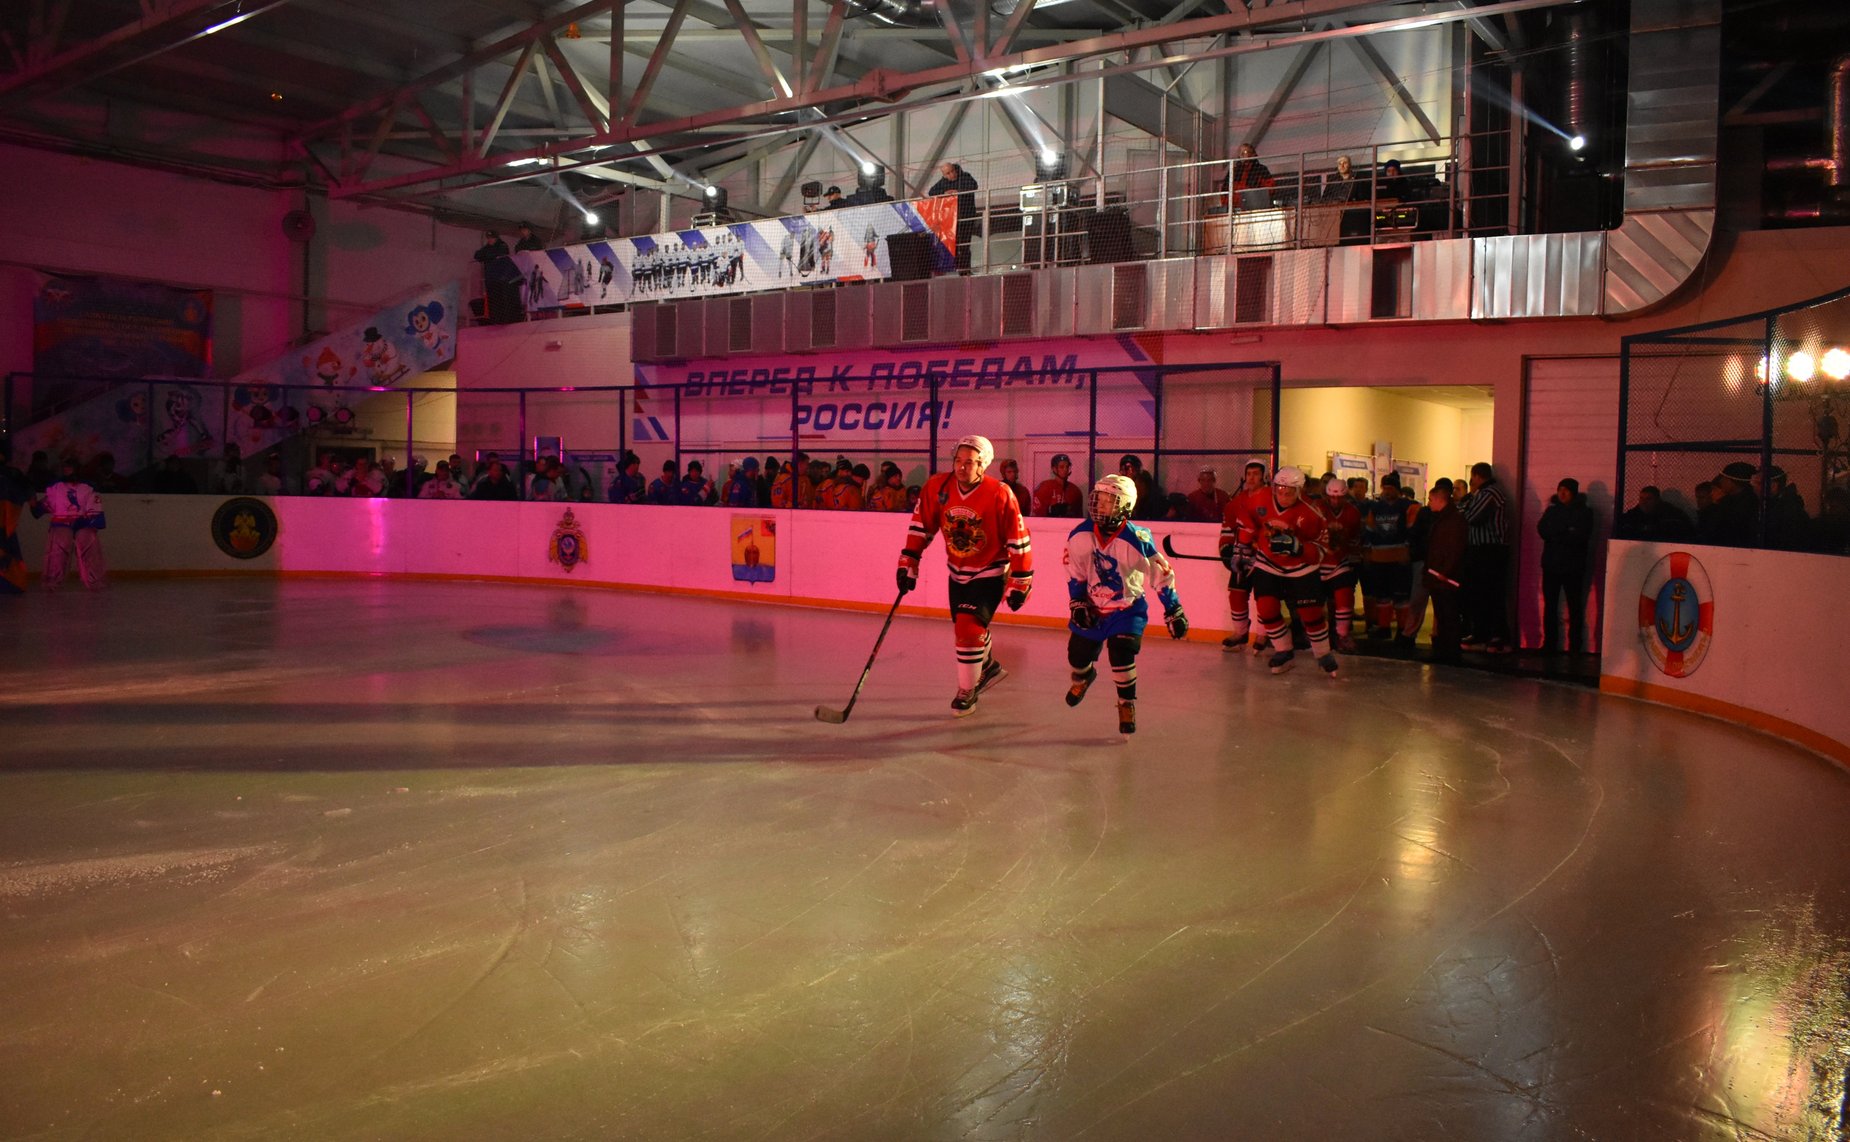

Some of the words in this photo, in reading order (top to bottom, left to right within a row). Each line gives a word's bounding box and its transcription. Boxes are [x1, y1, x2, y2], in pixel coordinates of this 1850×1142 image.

[828, 365, 853, 391] К
[867, 354, 1085, 390] ПОБЕДАМ,
[790, 400, 954, 431] РОССИЯ!
